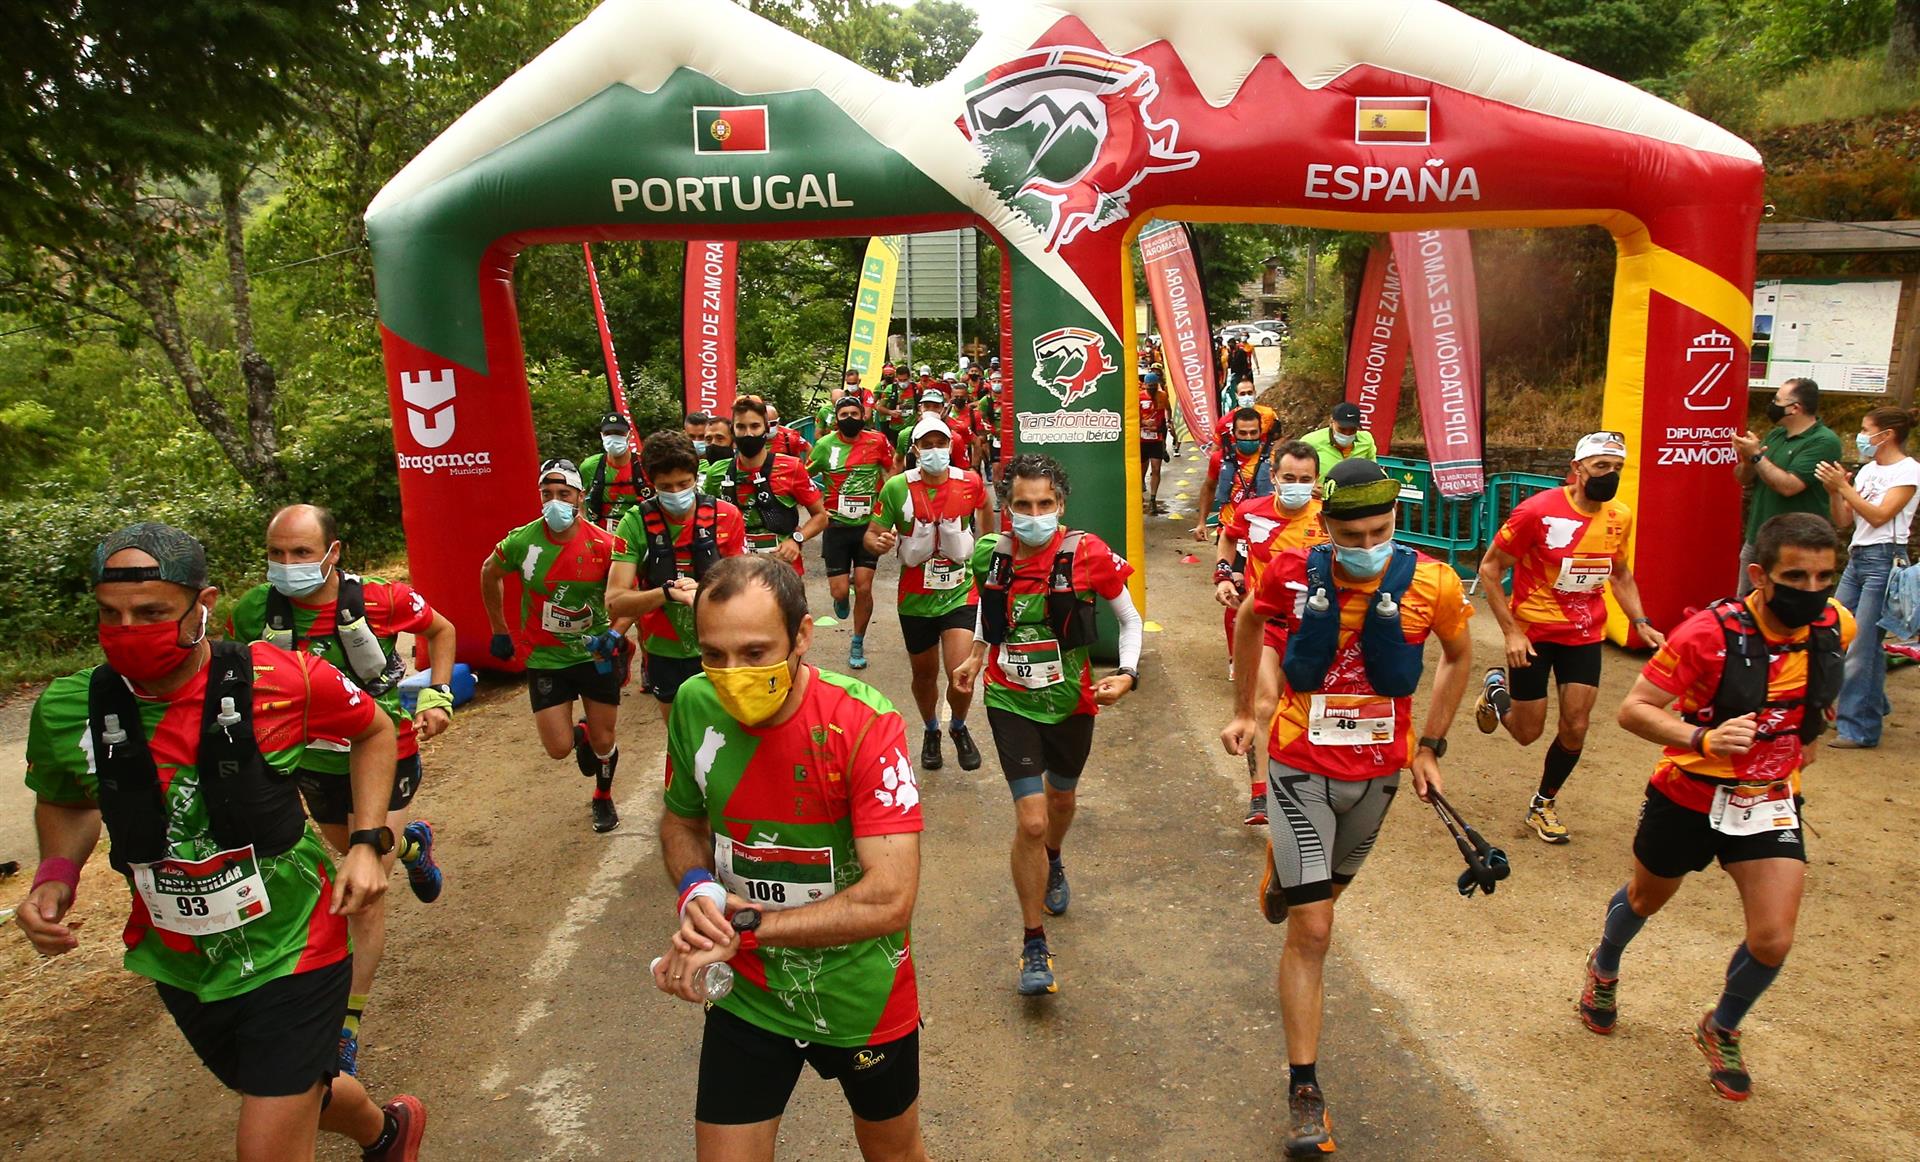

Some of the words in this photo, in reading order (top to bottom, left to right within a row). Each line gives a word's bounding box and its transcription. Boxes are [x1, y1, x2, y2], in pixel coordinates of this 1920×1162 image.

[1305, 159, 1481, 203] ESPAÑA
[611, 173, 854, 212] PORTUGAL
[703, 243, 724, 311] ZAMORA
[703, 313, 719, 336] DE
[1373, 314, 1394, 339] DE
[699, 340, 719, 419] PUTACIÓN
[1359, 343, 1388, 430] IPUTACIÓN
[1021, 431, 1083, 442] Campeonato
[1086, 430, 1118, 441] Ibérico
[397, 452, 490, 474] Bragança
[1657, 447, 1738, 465] ZAMORA
[449, 465, 492, 475] Município
[940, 574, 950, 582] 91
[1576, 575, 1587, 584] 12
[558, 620, 572, 628] 88
[1017, 665, 1033, 677] 82
[199, 865, 244, 892] VILLAR
[745, 881, 787, 904] 108
[176, 896, 210, 917] 93
